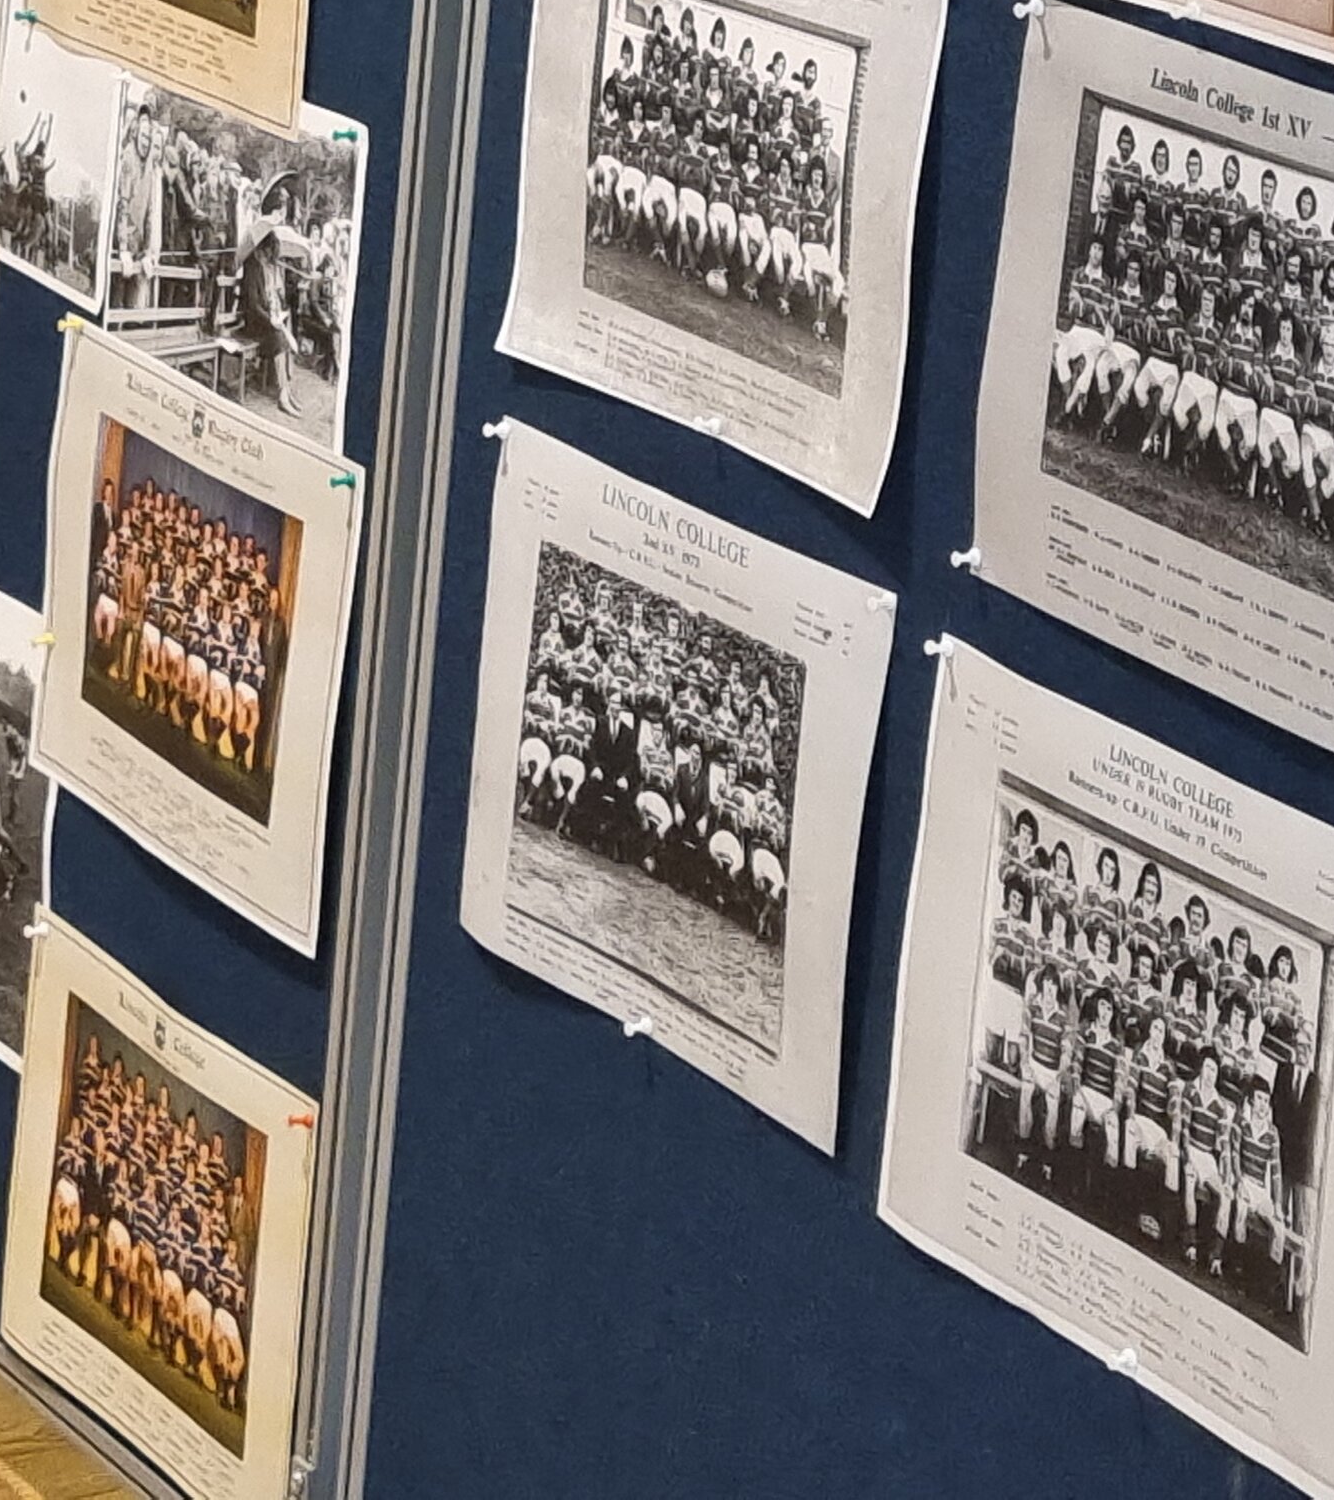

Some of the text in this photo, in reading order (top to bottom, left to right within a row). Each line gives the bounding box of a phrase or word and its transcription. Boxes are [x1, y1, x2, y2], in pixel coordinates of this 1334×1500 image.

[1150, 67, 1199, 102] Lincoln
[1206, 87, 1255, 123] College
[1262, 106, 1280, 131] 1st
[1286, 114, 1313, 139] XV
[602, 484, 670, 533] LINCOLN
[676, 518, 750, 568] COLLEGE
[1109, 744, 1233, 819] LINCOLN COLLEGE
[1148, 784, 1182, 813] RUGBY
[1188, 805, 1219, 831] TEAM
